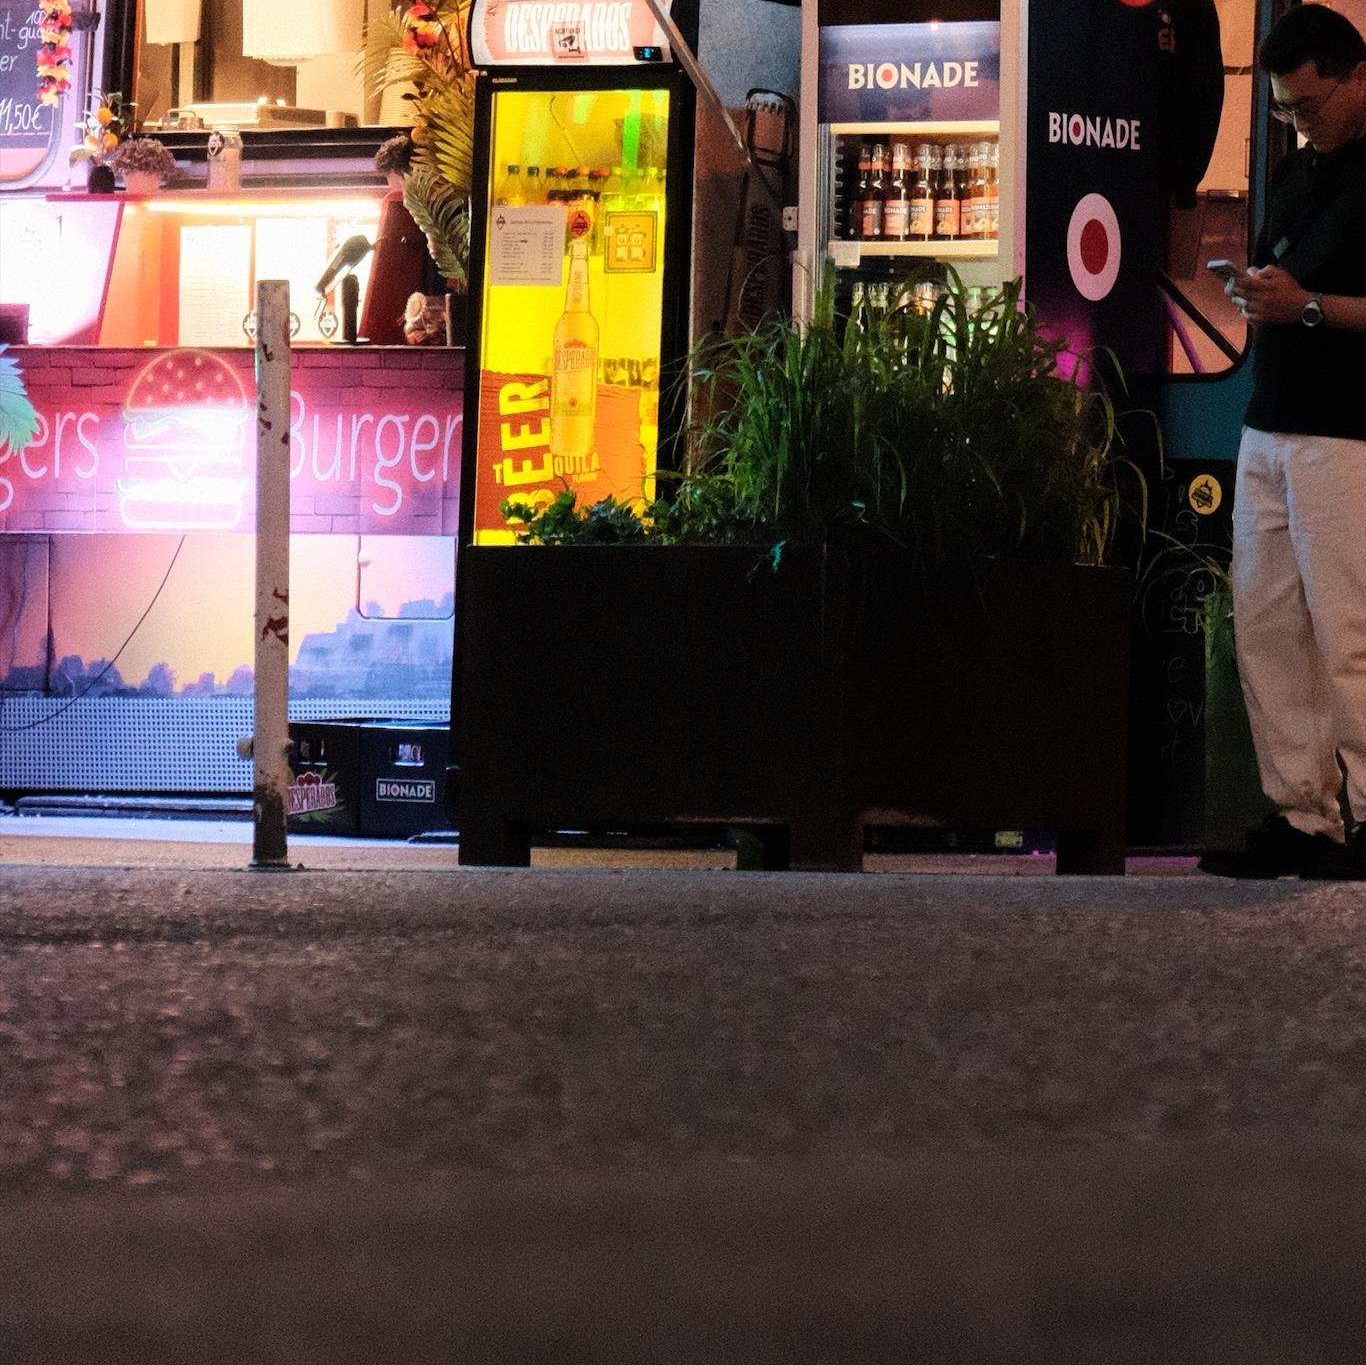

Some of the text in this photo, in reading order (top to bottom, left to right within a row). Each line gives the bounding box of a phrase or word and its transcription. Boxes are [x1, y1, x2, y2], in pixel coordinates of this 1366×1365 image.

[848, 61, 979, 90] BIONADE
[1049, 111, 1141, 151] BIONADE
[288, 784, 336, 816] ESPERADOS
[379, 782, 433, 799] BIONADE
